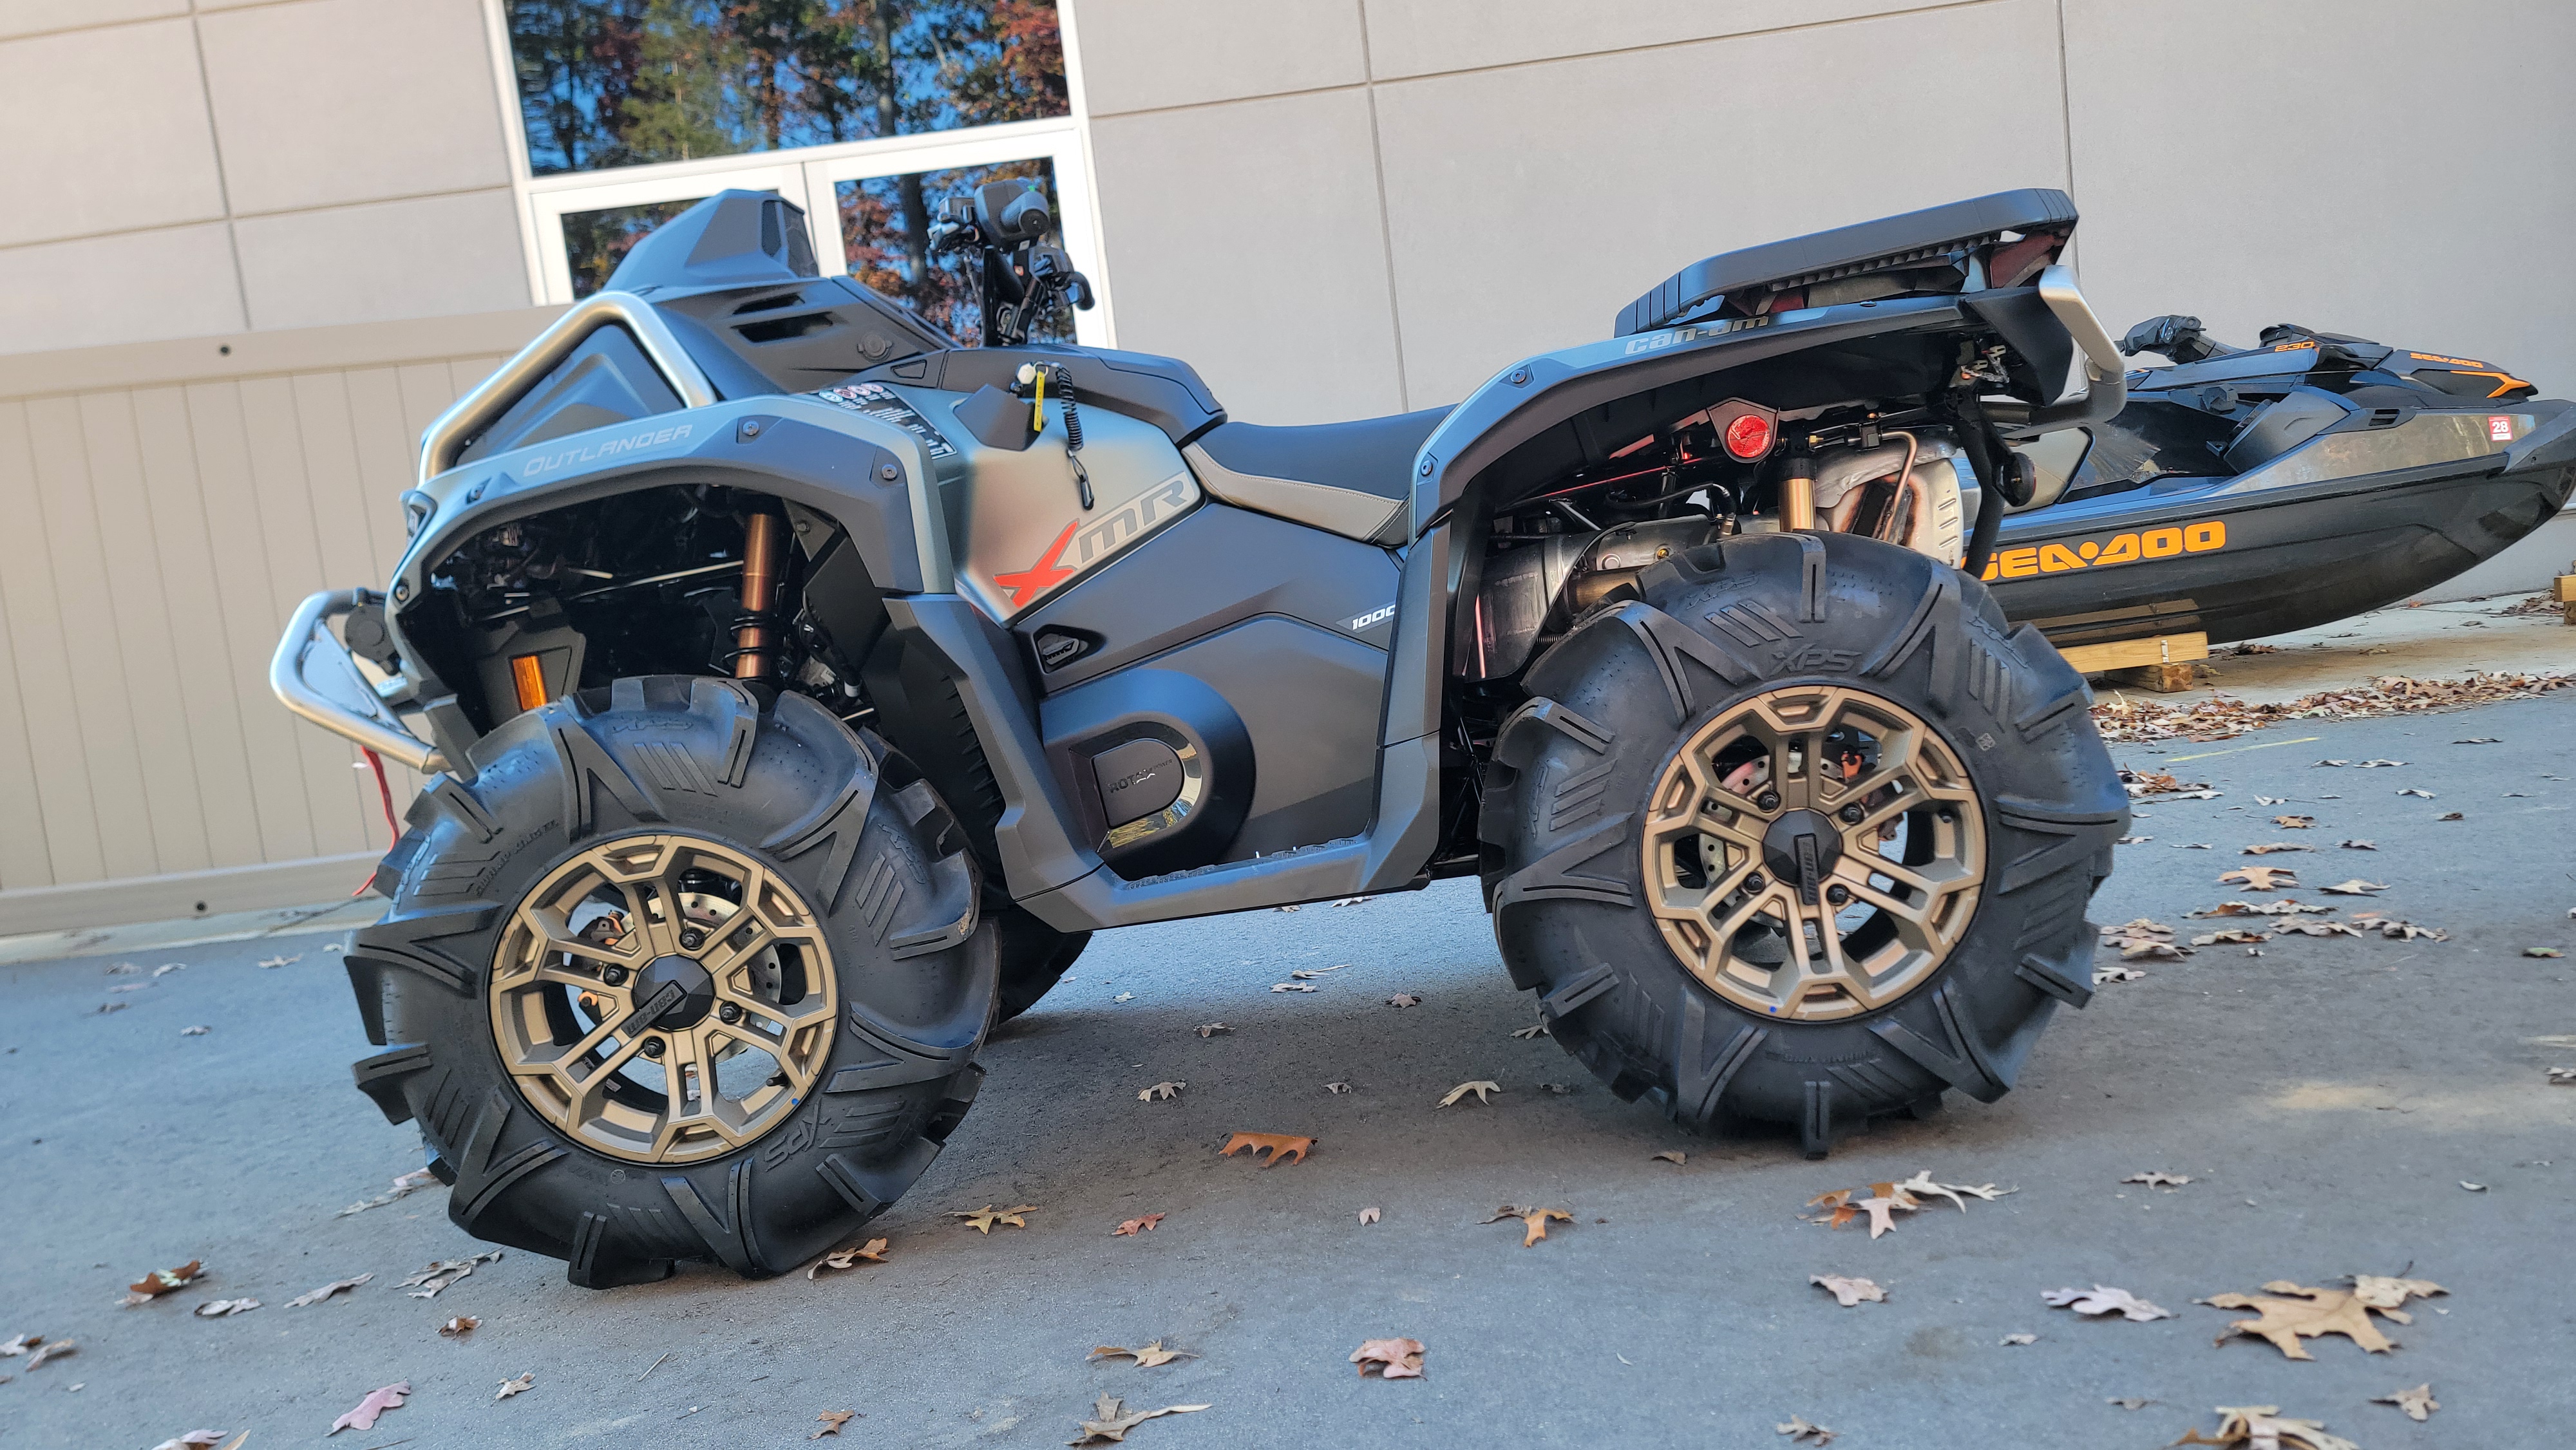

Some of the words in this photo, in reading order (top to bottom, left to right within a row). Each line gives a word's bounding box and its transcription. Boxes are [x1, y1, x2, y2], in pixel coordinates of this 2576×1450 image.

[1624, 315, 1770, 355] can-am
[2274, 341, 2315, 352] 230
[2492, 421, 2509, 433] 28
[523, 424, 693, 477] OUTLANDER
[1770, 643, 1864, 677] XPS
[1108, 767, 1157, 793] ROTAX
[626, 988, 676, 1035] can-am
[764, 1097, 833, 1172] XPS
